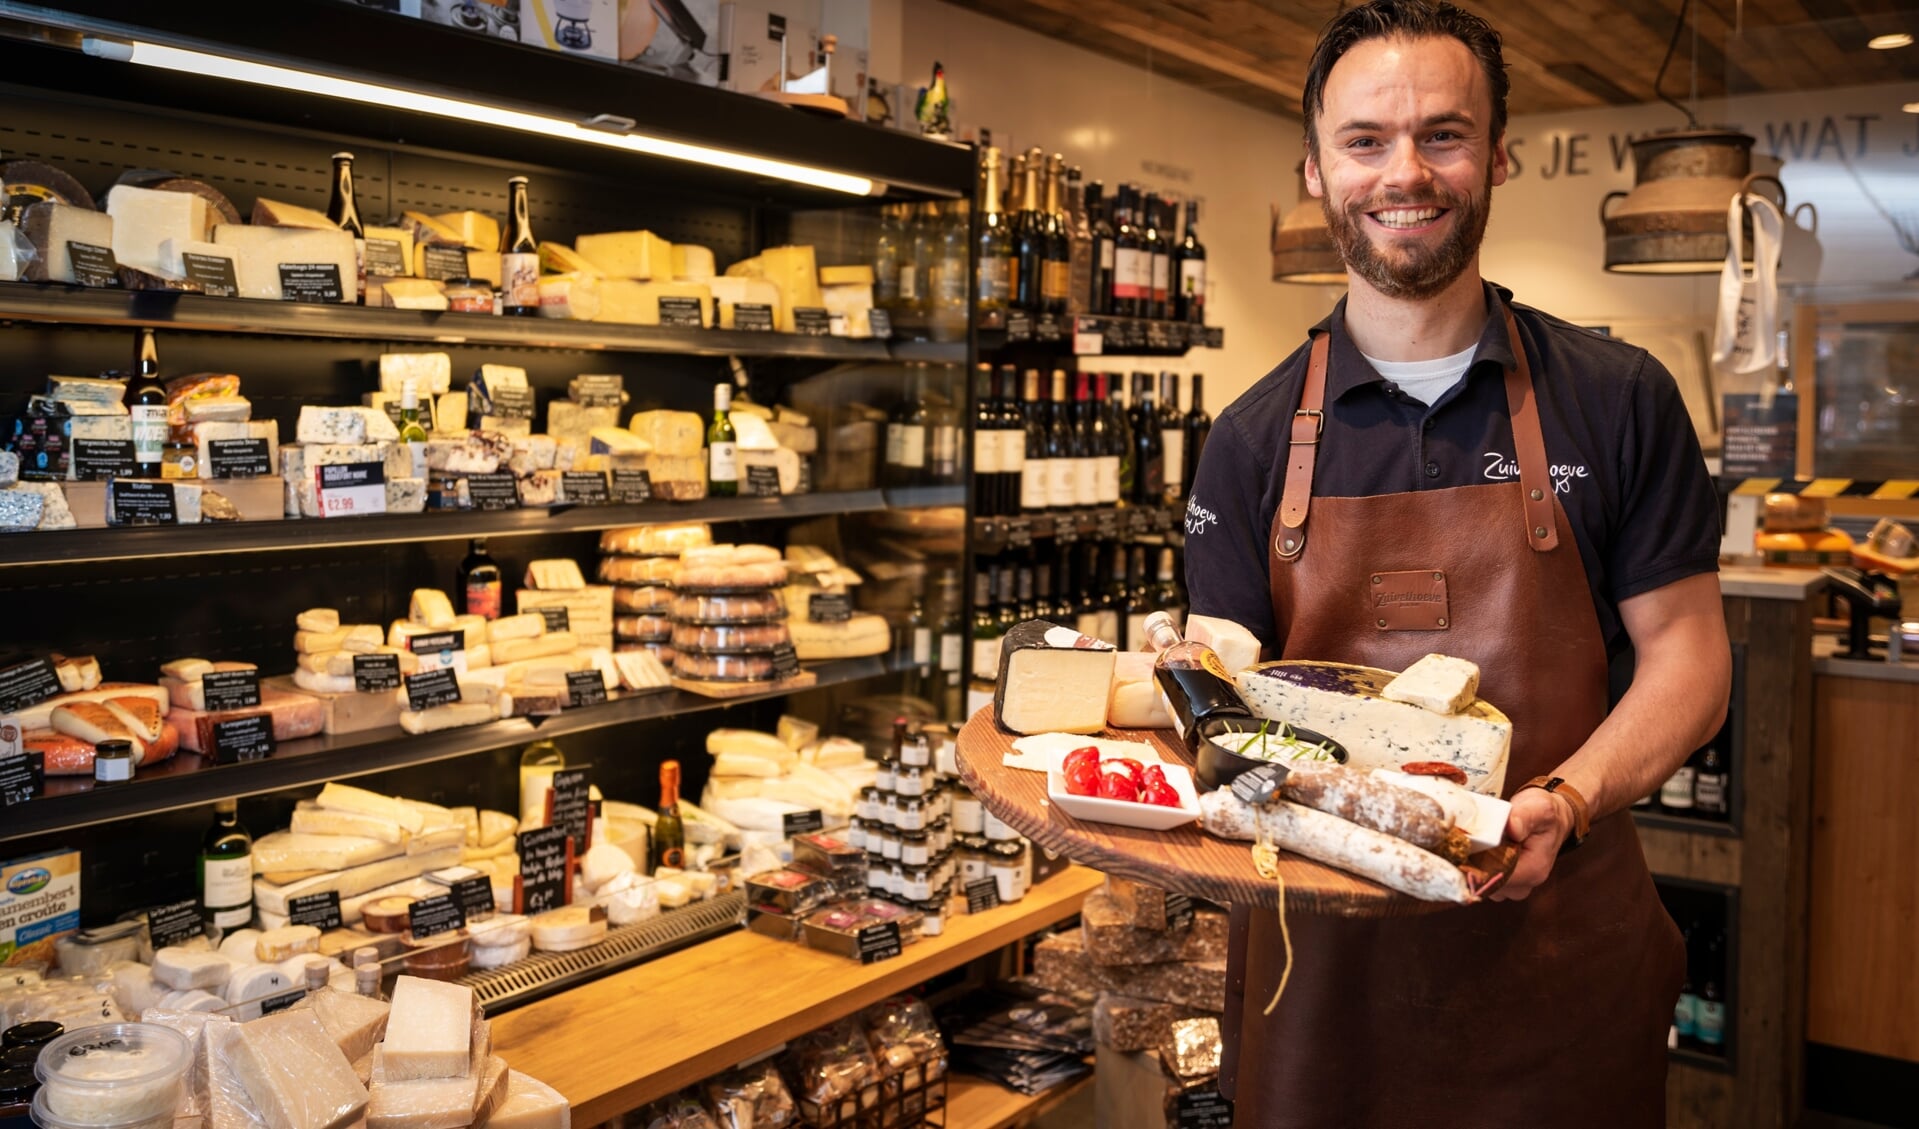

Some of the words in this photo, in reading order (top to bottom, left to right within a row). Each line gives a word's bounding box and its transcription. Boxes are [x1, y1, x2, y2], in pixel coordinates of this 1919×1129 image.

[1540, 132, 1590, 180] JE
[1765, 113, 1882, 162] WAT
[1483, 452, 1589, 479] Zuivoeve
